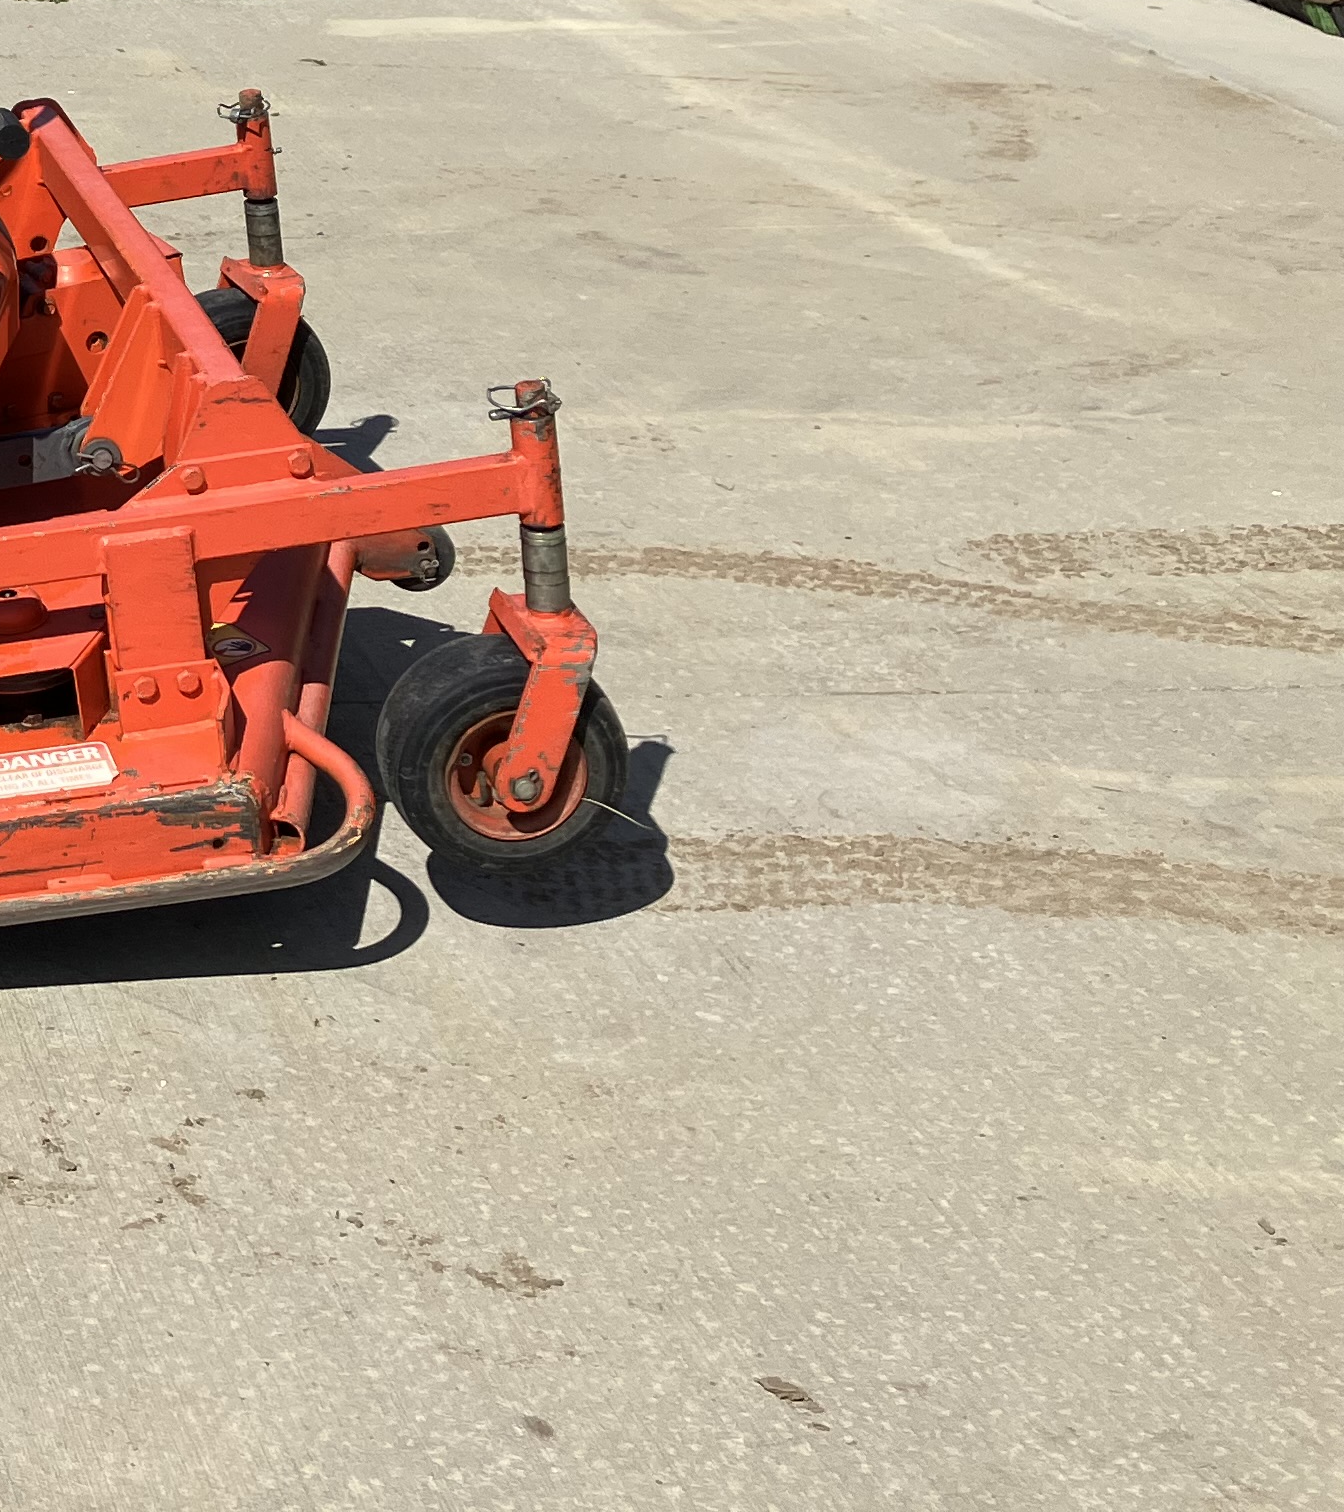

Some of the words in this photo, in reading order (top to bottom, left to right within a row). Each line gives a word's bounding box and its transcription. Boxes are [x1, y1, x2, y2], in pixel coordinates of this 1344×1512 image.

[31, 770, 43, 778] OF
[46, 762, 105, 777] DISCHARGE
[22, 780, 34, 788] AT
[37, 778, 55, 787] ALL
[60, 774, 94, 785] TIMES
